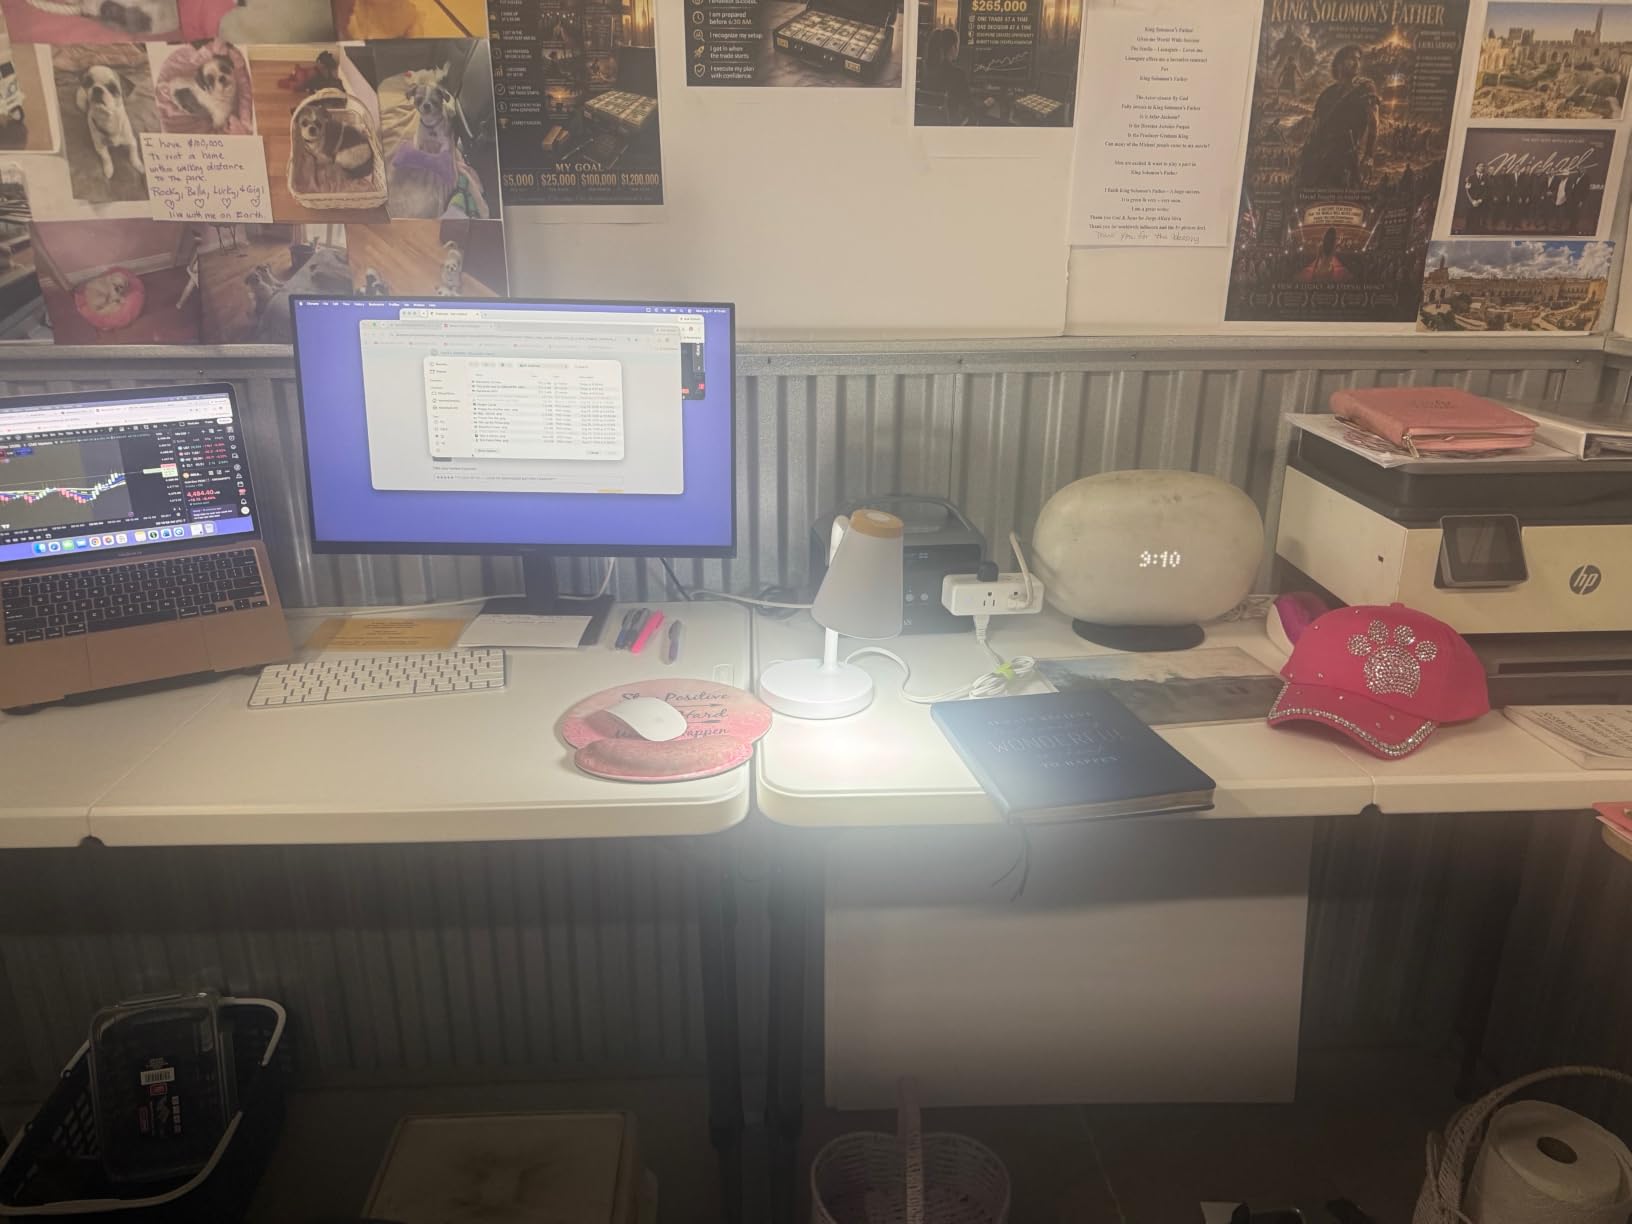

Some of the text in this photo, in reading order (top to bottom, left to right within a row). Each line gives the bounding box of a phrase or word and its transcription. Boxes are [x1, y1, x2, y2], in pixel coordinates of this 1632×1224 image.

[972, 0, 1027, 12] $265,000
[1271, 0, 1446, 25] KING SOLOMON'S FATHER
[144, 138, 153, 147] I
[159, 139, 182, 148] have
[202, 152, 225, 160] home
[177, 164, 204, 175] walking
[207, 162, 245, 171] distance
[555, 163, 604, 172] MY GOAL
[1487, 147, 1598, 178] Michael
[503, 174, 534, 187] $5,000
[541, 174, 576, 186] $25,000
[581, 174, 617, 185] $100,000
[186, 211, 203, 219] with
[1570, 564, 1601, 595] hp
[664, 692, 728, 703] Positive
